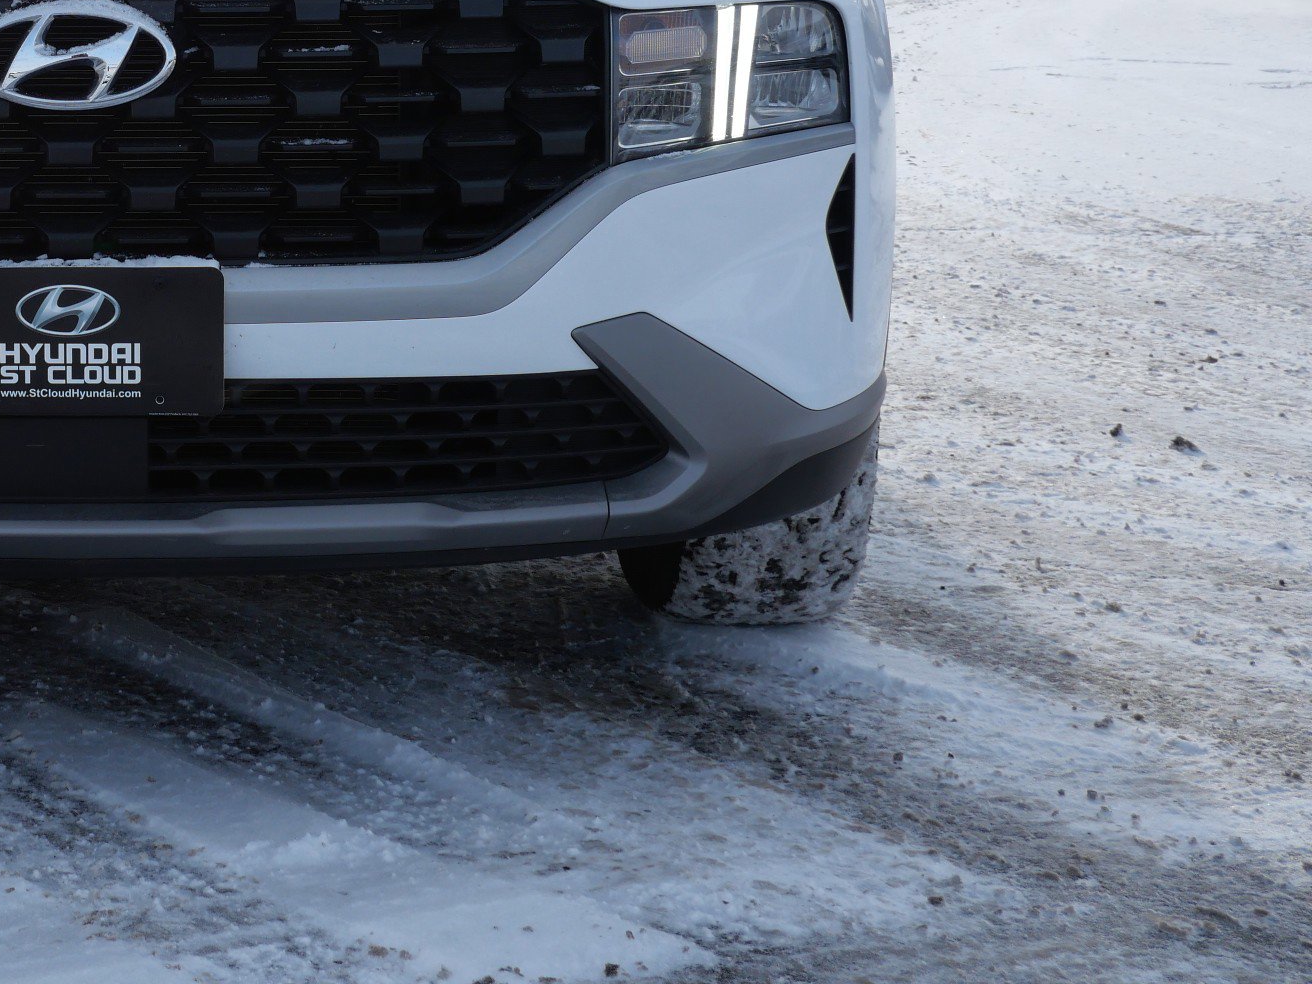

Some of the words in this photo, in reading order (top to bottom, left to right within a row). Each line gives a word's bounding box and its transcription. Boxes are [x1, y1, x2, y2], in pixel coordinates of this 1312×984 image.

[0, 343, 141, 364] HYUNDAI
[0, 365, 37, 385] ST
[47, 365, 142, 385] CLOUD
[0, 388, 142, 400] www.StCloudHyundai.com
